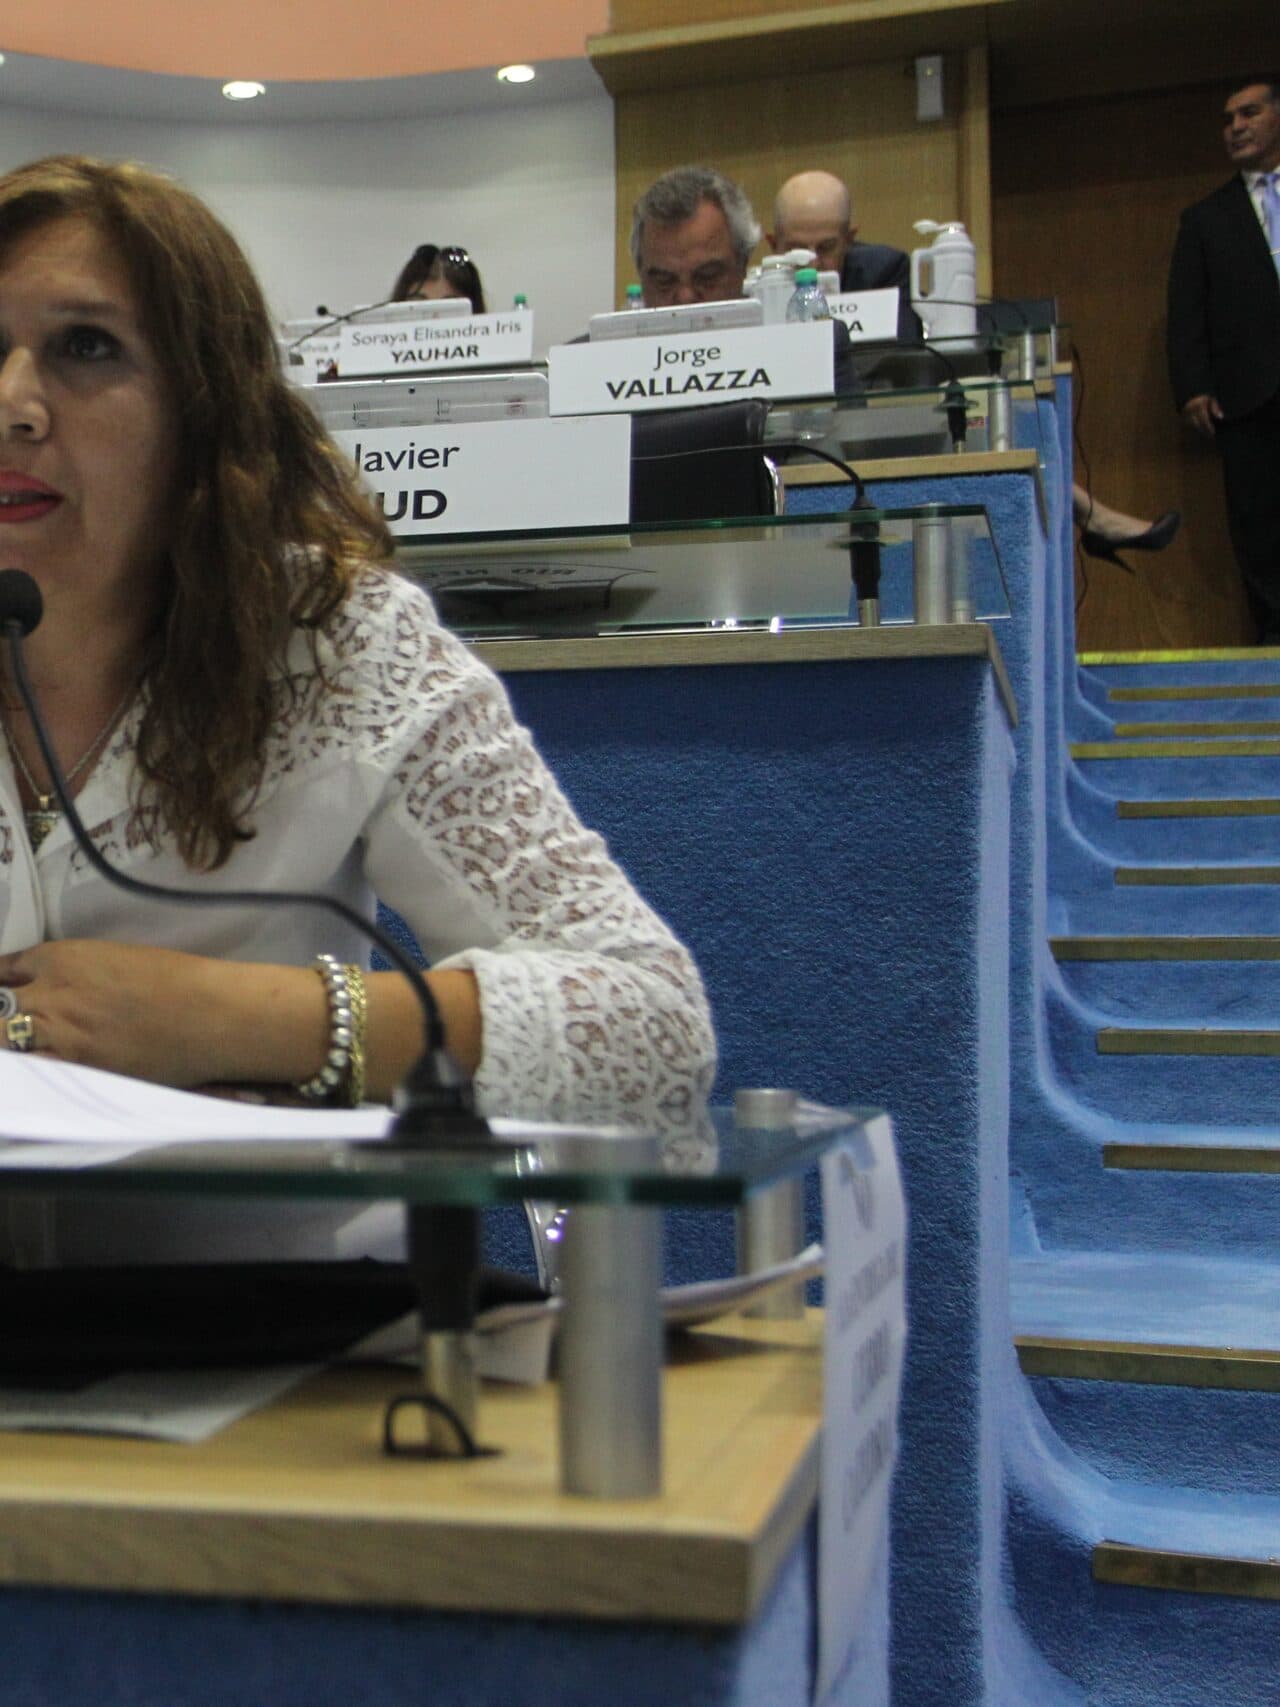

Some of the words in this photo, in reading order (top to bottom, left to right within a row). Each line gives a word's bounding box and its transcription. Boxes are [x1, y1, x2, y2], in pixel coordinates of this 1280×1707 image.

[352, 331, 409, 350] Soraya
[414, 320, 490, 343] Elisandra
[495, 319, 522, 335] Iris
[391, 344, 481, 366] YAUHAR
[653, 346, 722, 372] Jorge
[605, 367, 772, 401] VALLAZZA
[375, 488, 449, 523] UD
